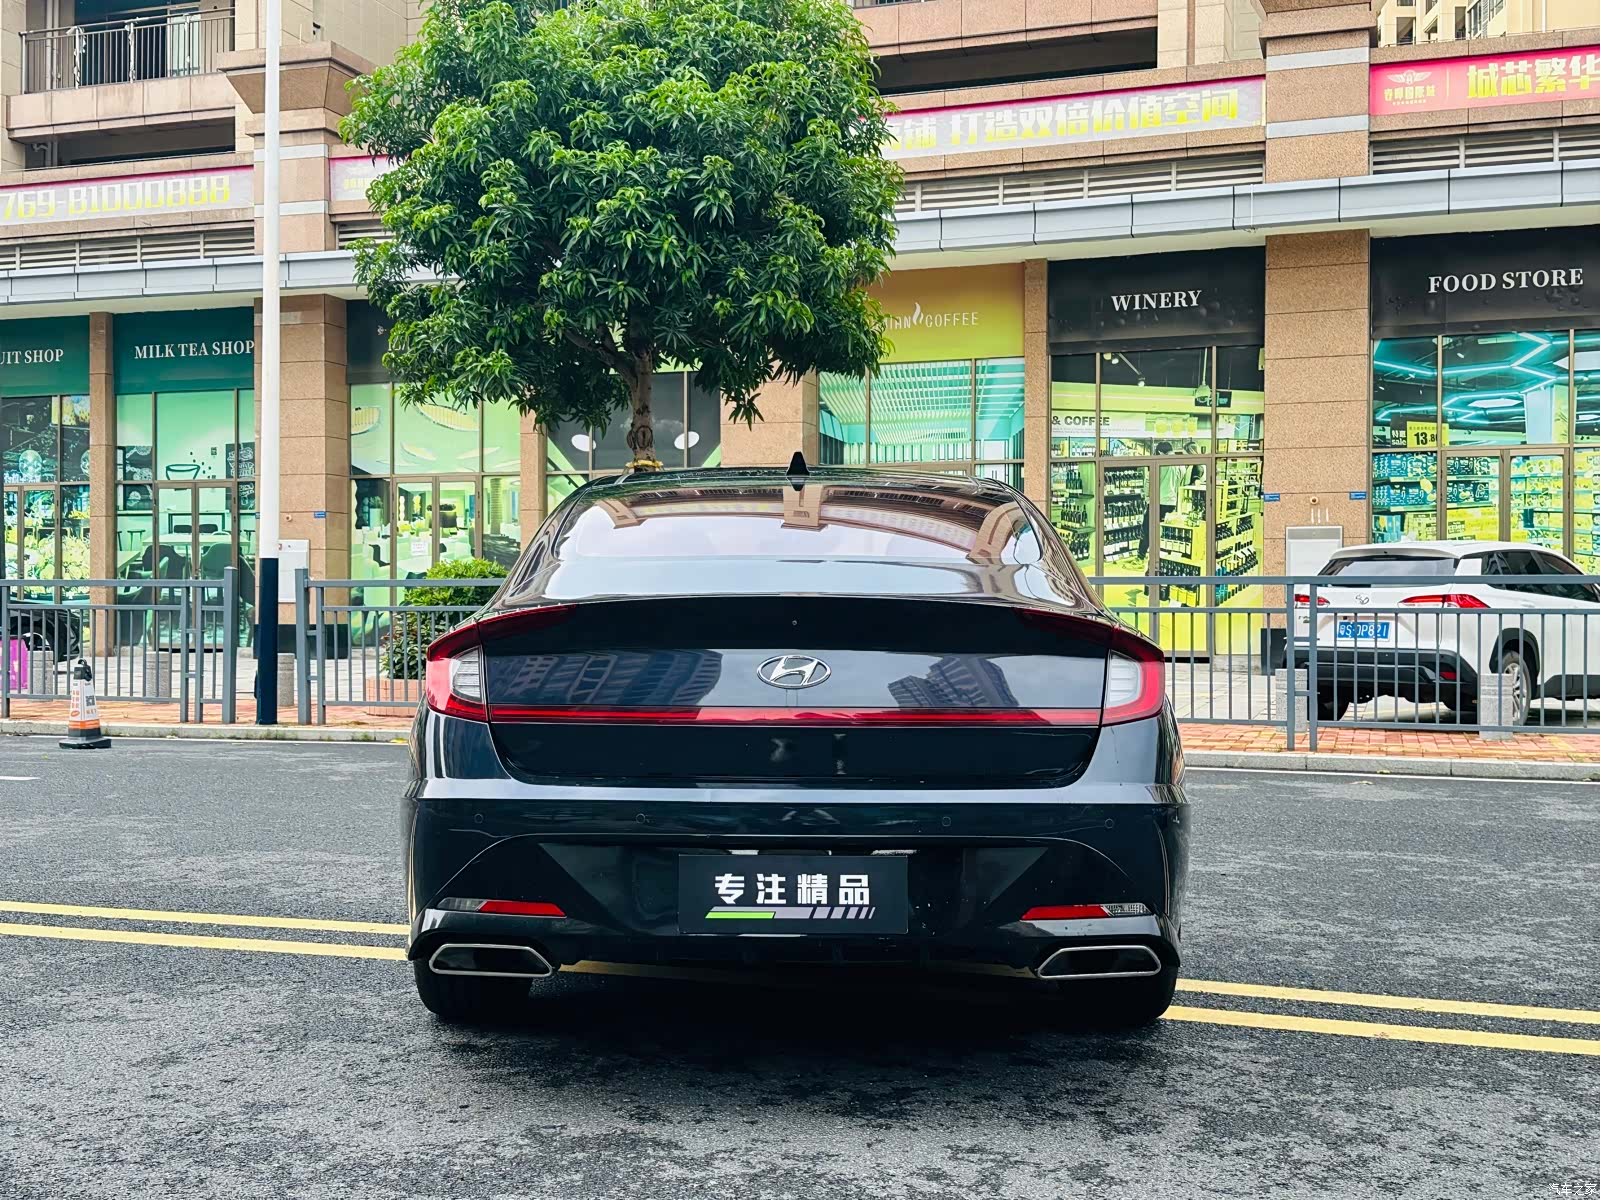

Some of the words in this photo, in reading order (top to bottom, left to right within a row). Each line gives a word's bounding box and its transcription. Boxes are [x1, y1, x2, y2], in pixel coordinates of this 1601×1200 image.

[1467, 54, 1600, 99] 城芯繁华
[949, 88, 1238, 146] 打造双倍价值空间
[1428, 273, 1497, 293] FOOD
[1502, 268, 1584, 289] STORE
[1111, 289, 1202, 312] WINERY
[925, 311, 979, 328] COFFEE
[24, 348, 64, 364] SHOP
[134, 343, 175, 359] MILK
[178, 342, 209, 357] TEA
[212, 339, 255, 355] SHOP
[1391, 438, 1407, 446] sale
[714, 873, 870, 905] 专注精品
